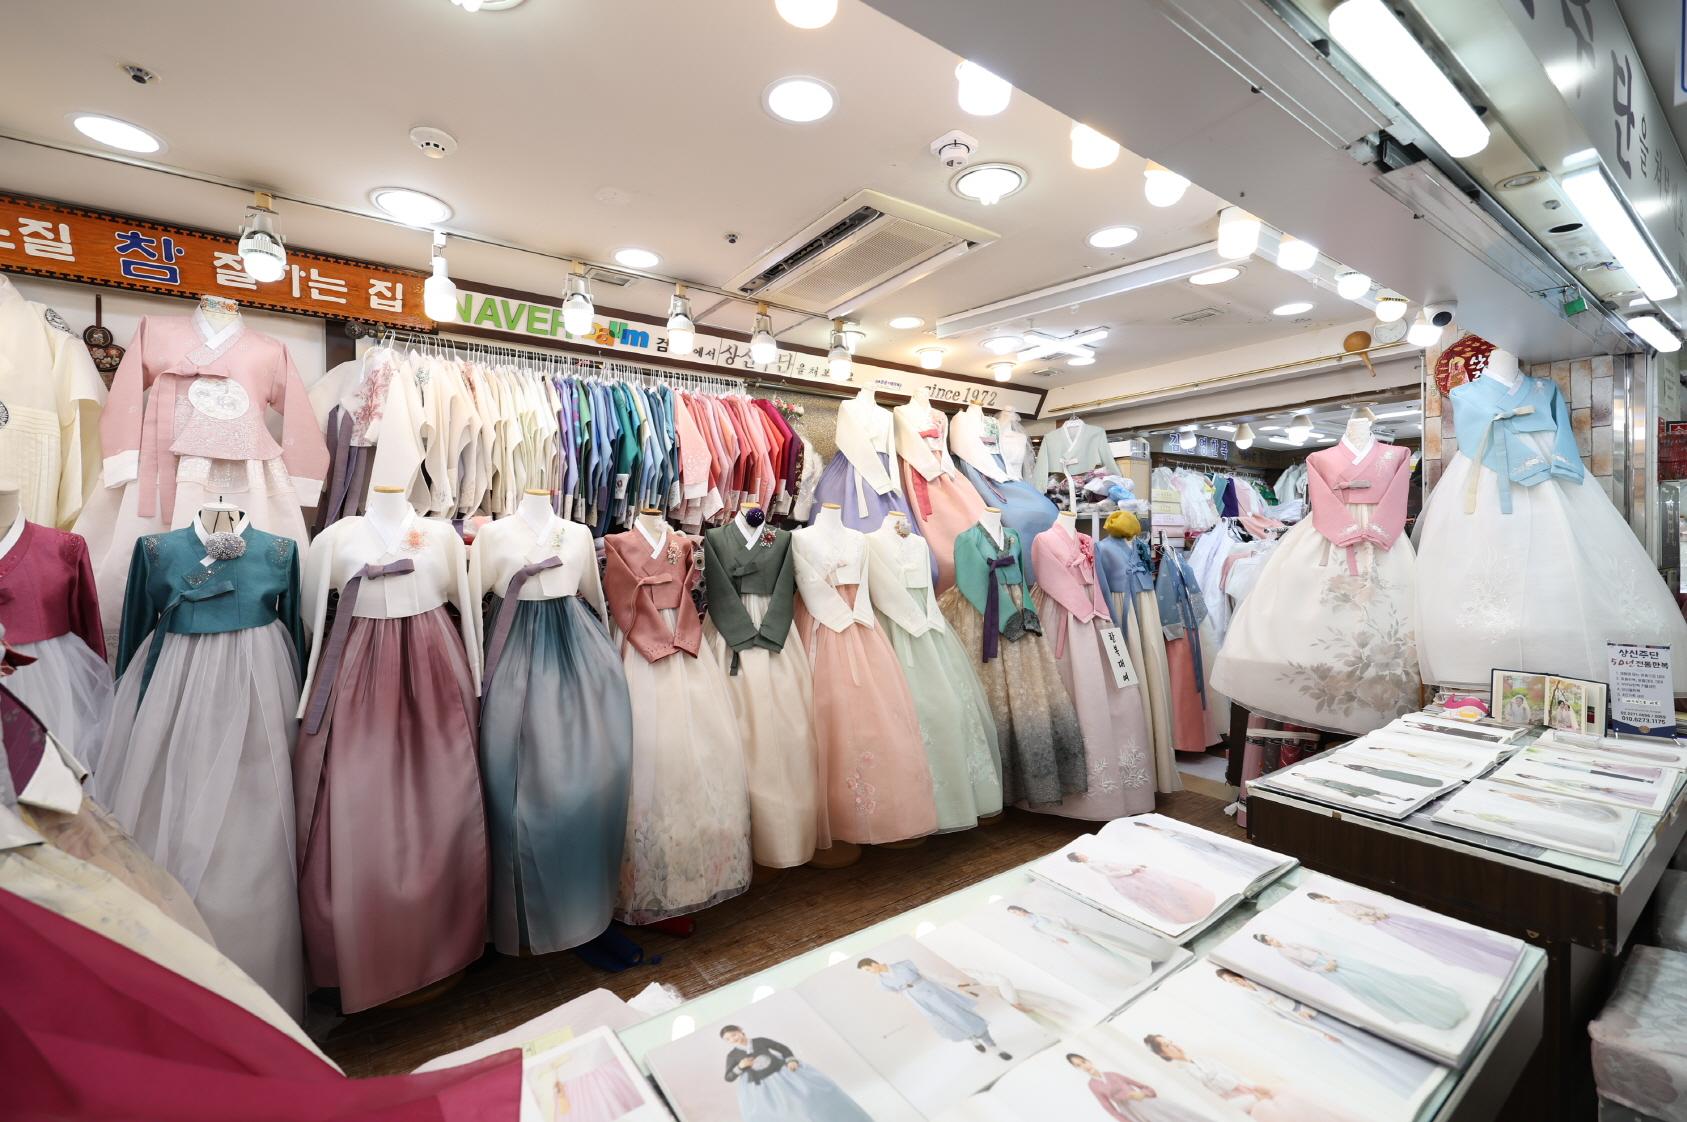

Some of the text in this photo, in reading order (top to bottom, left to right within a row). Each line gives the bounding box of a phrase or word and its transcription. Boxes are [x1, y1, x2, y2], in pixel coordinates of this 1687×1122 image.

[114, 230, 185, 286] 참
[368, 278, 403, 313] 집
[656, 337, 715, 361] 검에서
[719, 343, 794, 373] 상신단
[1169, 433, 1229, 461] 김영한복
[1619, 649, 1659, 659] 상신주단
